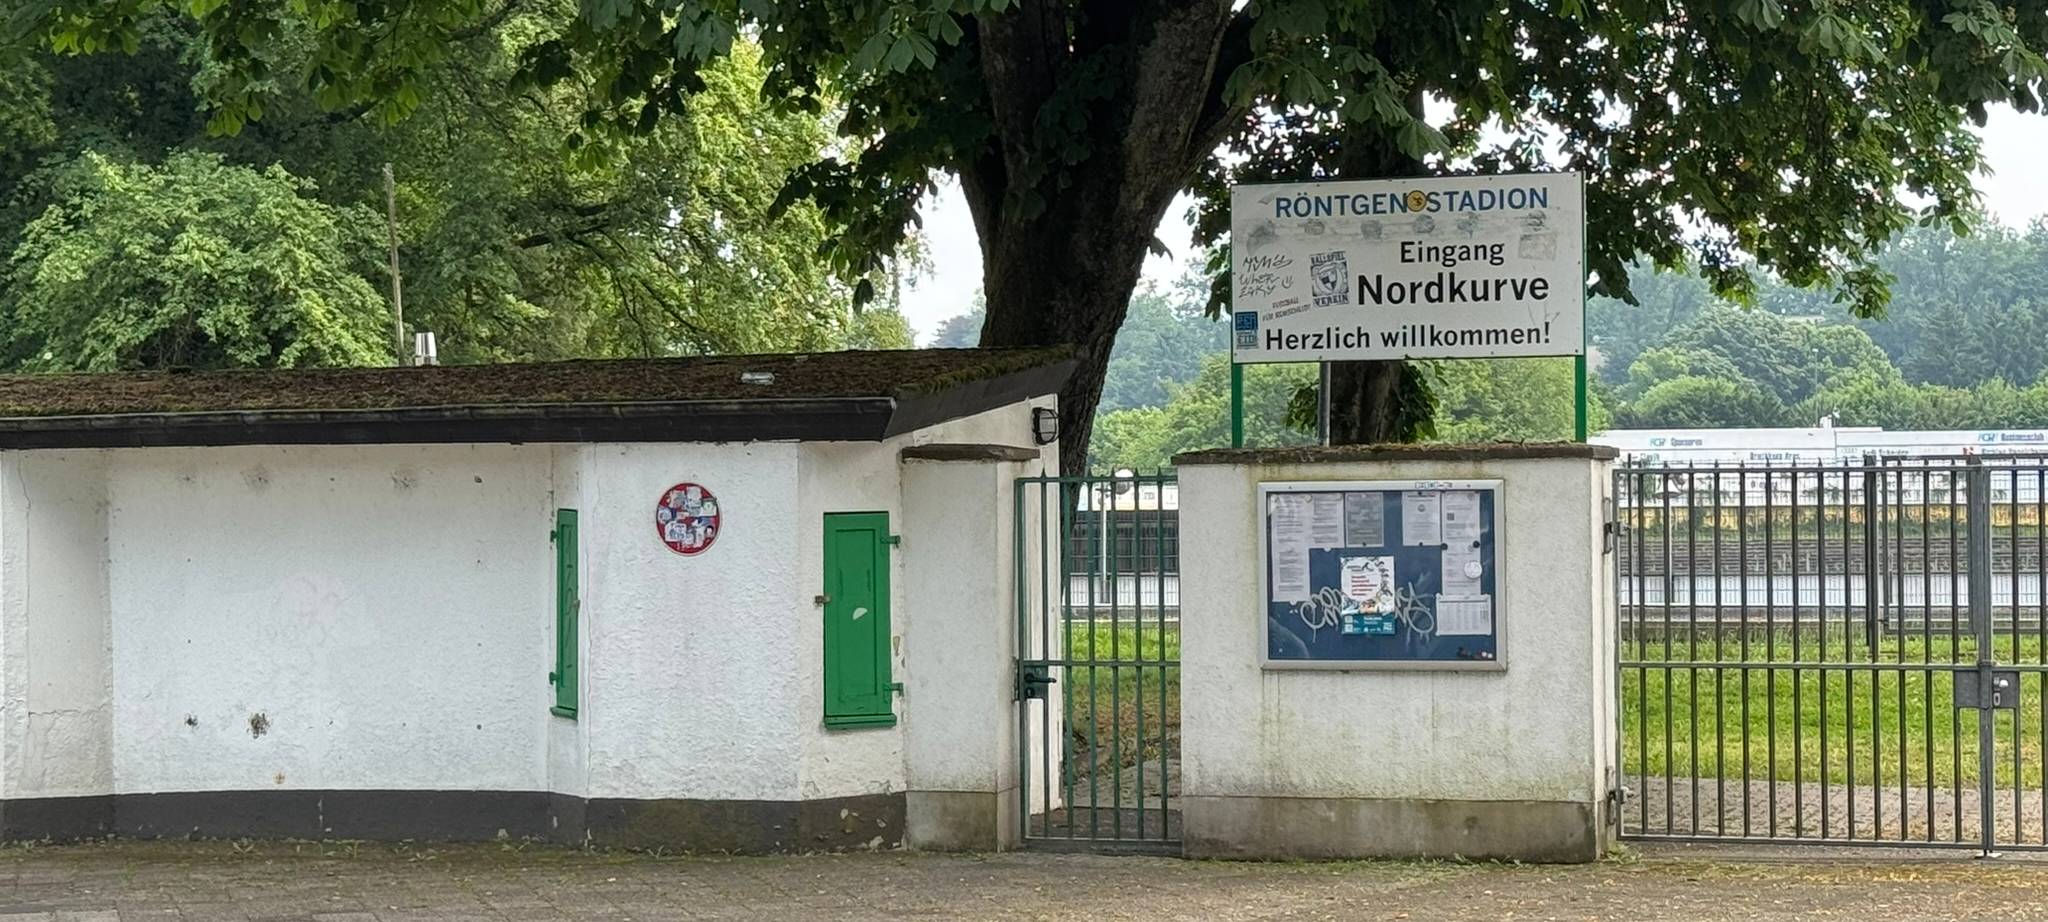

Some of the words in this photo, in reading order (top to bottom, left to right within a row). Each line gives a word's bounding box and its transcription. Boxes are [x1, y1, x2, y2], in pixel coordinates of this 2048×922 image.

[1275, 191, 1408, 218] RÖNTGEN
[1426, 186, 1549, 212] STADION
[1400, 241, 1506, 267] Eingang
[1313, 294, 1349, 307] VEREIN
[1358, 272, 1550, 305] Nordkurve
[1266, 326, 1371, 350] Herzlich
[1380, 321, 1551, 348] willkommen!
